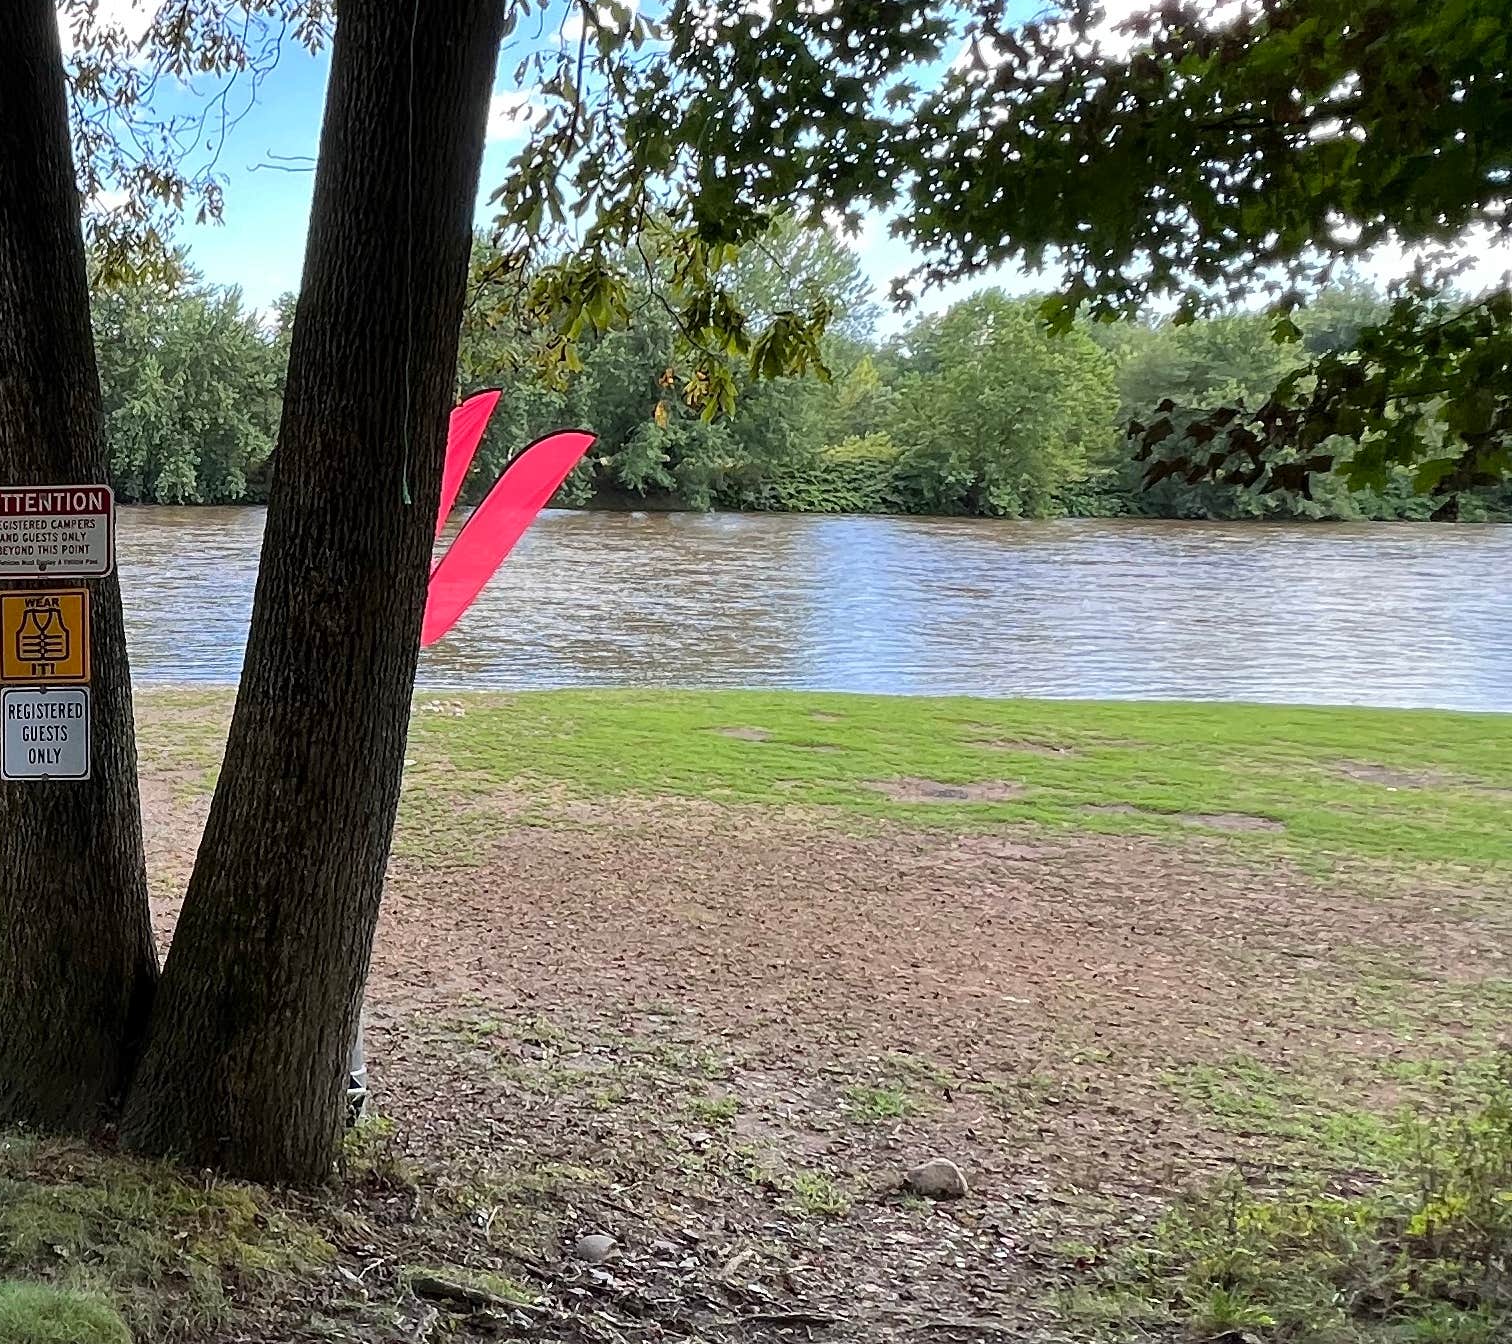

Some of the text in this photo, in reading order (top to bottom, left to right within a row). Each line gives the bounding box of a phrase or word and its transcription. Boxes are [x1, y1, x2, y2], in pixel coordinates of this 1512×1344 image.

[50, 519, 96, 530] CAMPERS
[0, 532, 87, 543] AND GUESTS ONLY
[38, 545, 58, 555] THIS
[61, 544, 91, 555] POINT
[25, 598, 60, 608] WEAR
[31, 663, 56, 675] IT!
[8, 703, 82, 719] REGISTERED
[22, 725, 68, 742] GUESTS
[28, 748, 62, 764] ONLY
